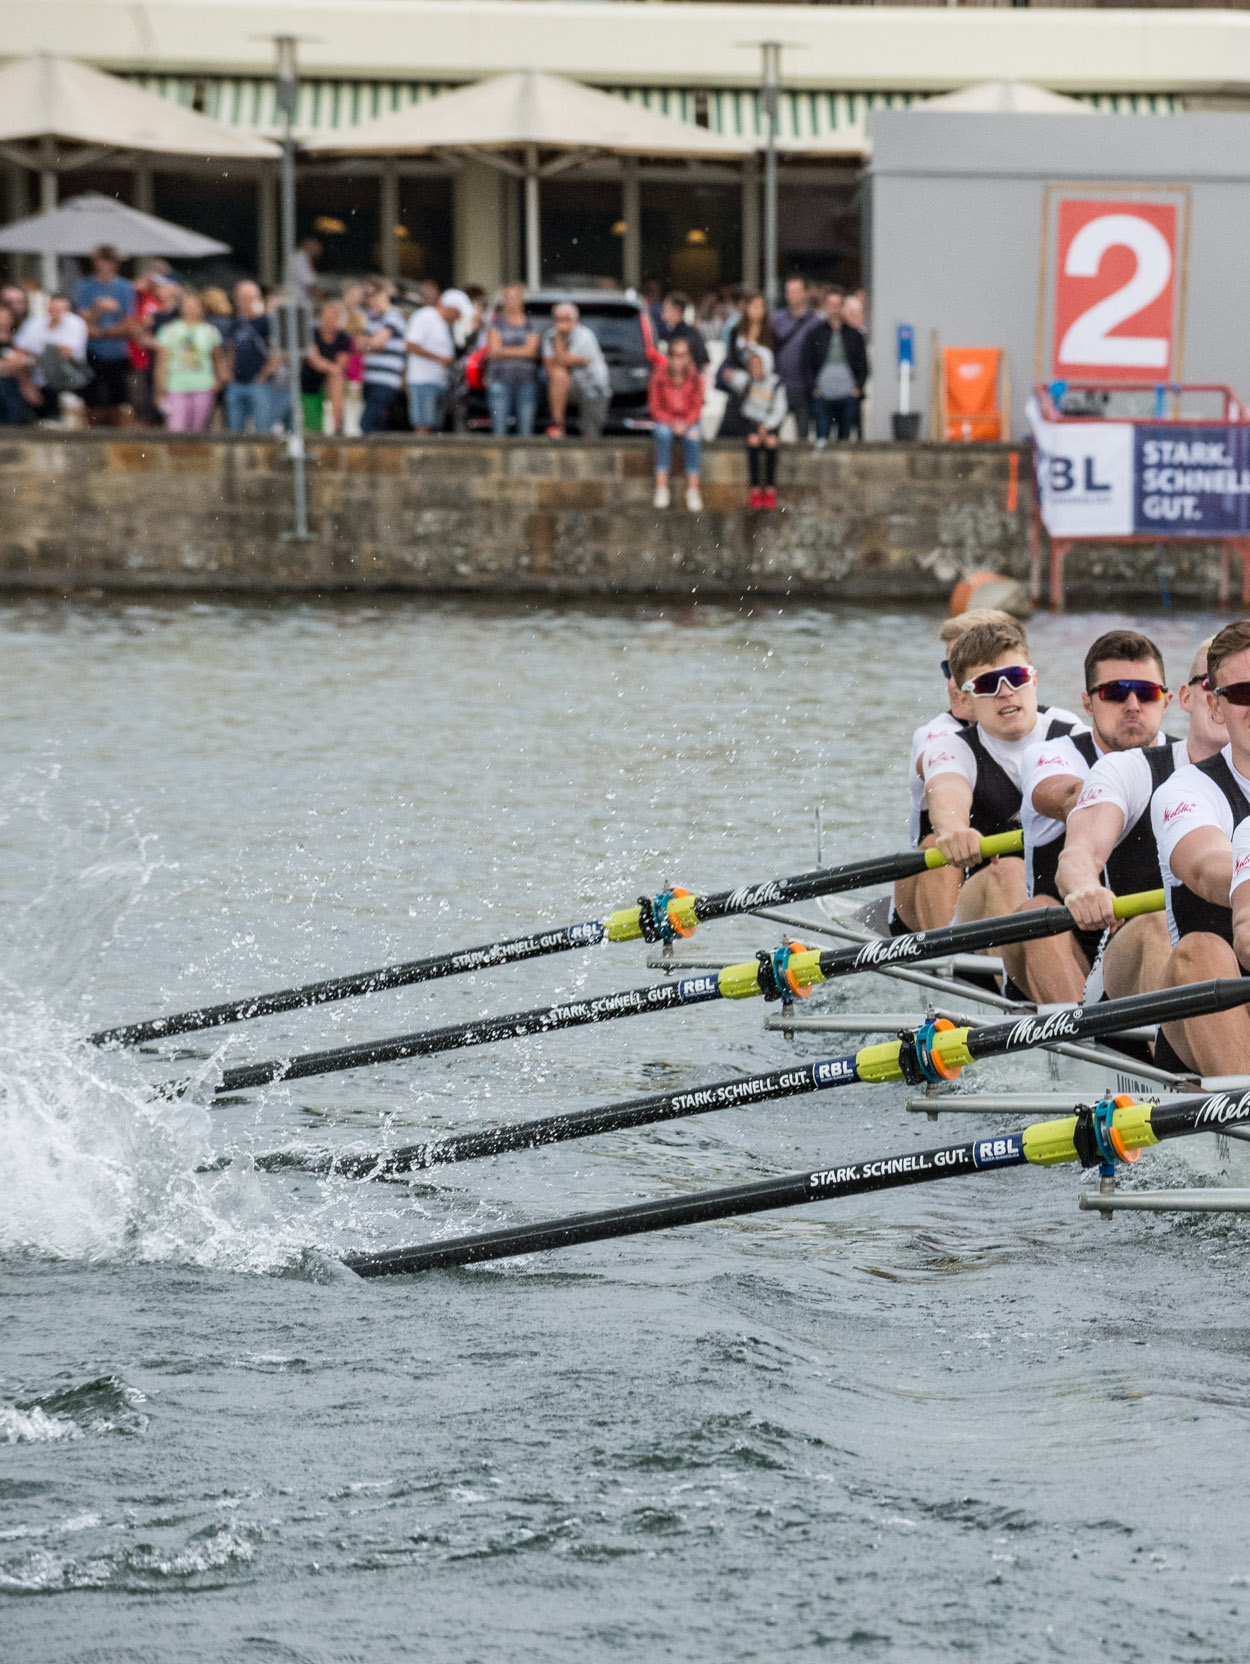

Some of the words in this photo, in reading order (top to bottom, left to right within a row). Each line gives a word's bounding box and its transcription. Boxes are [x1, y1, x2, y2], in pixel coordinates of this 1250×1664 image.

[1059, 213, 1173, 368] 2
[1142, 441, 1234, 466] STARK.
[1142, 495, 1202, 521] GUT.
[571, 923, 600, 939] RBL
[591, 991, 646, 1013] SCHNELL.
[648, 986, 676, 1002] GUT.
[683, 978, 716, 994] RBL
[671, 1092, 717, 1111] STARK.
[718, 1078, 779, 1100] SCHNELL.
[779, 1070, 810, 1088] GUT.
[818, 1060, 853, 1079] RBL
[809, 1167, 860, 1187] STARK.
[862, 1155, 932, 1179] SCHNELL.
[933, 1149, 968, 1167] GUT.
[979, 1138, 1019, 1158] RBL
